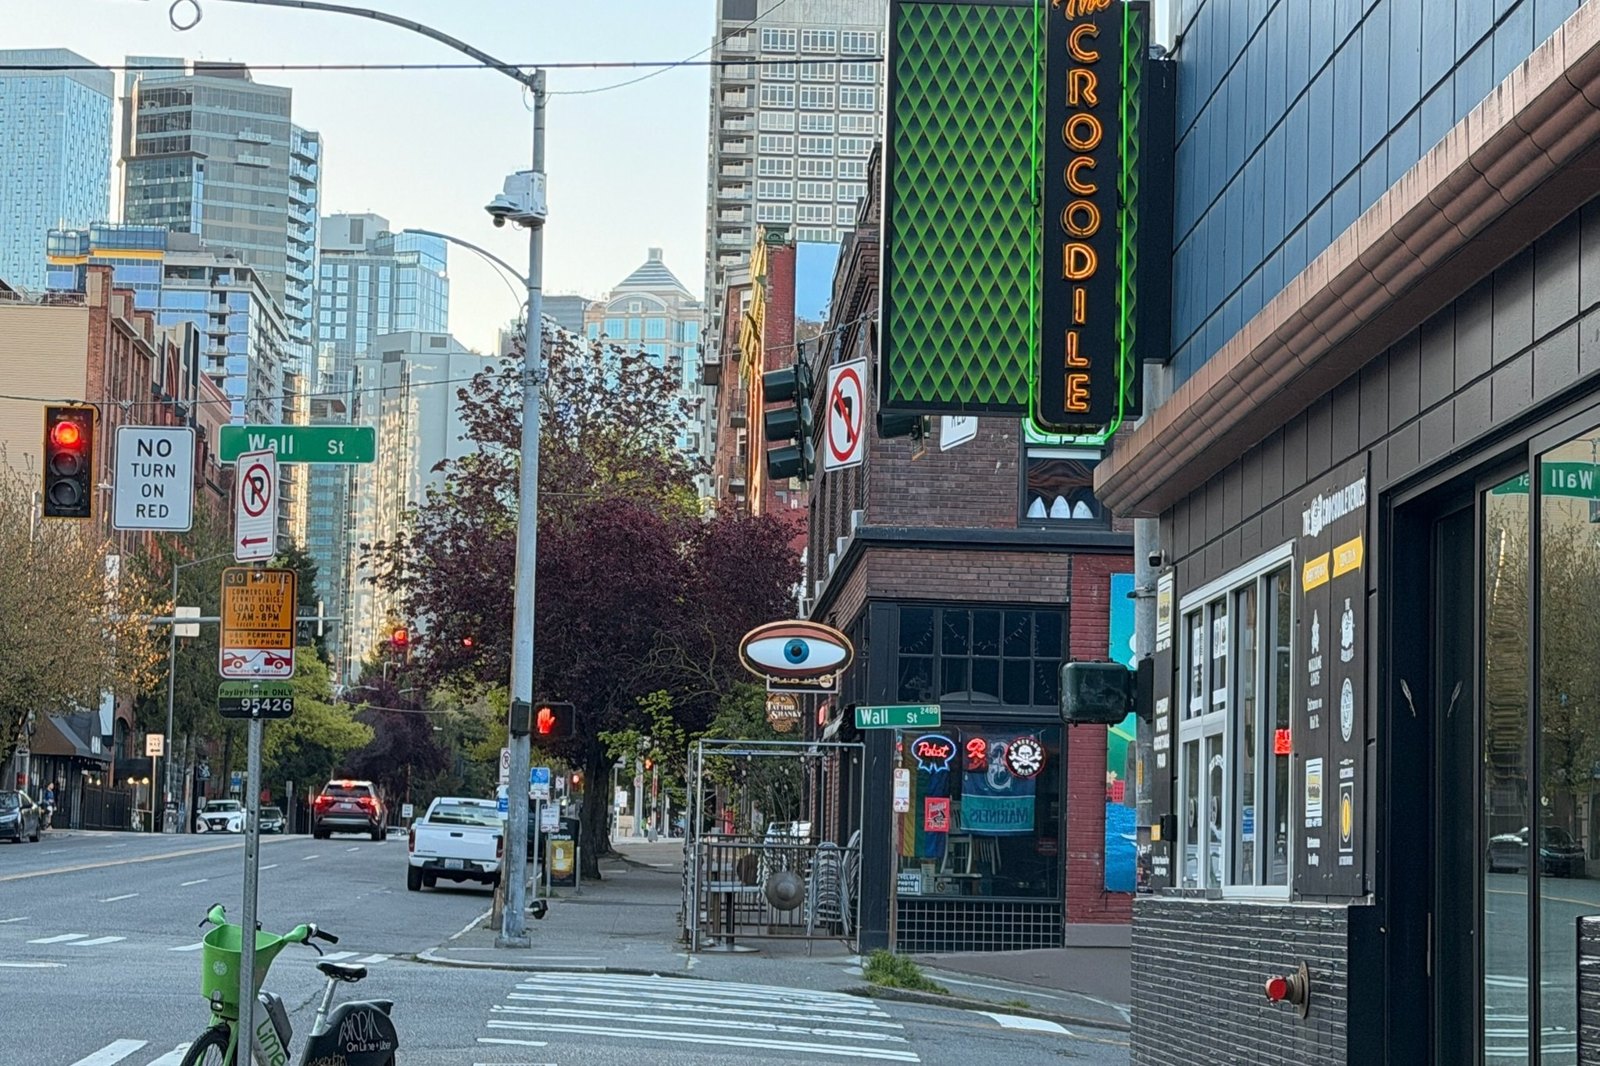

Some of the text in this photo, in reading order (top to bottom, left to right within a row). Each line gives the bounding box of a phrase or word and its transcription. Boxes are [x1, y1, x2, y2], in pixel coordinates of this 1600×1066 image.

[1062, 23, 1104, 412] CROCODILE
[137, 439, 172, 457] NO
[248, 434, 344, 455] Wall St
[131, 463, 176, 478] TURN
[141, 484, 164, 498] ON
[136, 504, 169, 518] RED
[227, 573, 244, 584] 30
[233, 604, 282, 612] LOAD ONLY
[237, 613, 254, 622] 7AM
[261, 613, 279, 622] 8PM
[271, 688, 293, 697] ONLY
[241, 698, 293, 711] 95426
[766, 700, 795, 711] TATTOO
[861, 706, 938, 725] Wall St 2400
[918, 742, 950, 758] Pabst
[256, 1017, 286, 1066] Lime
[346, 1041, 359, 1053] On
